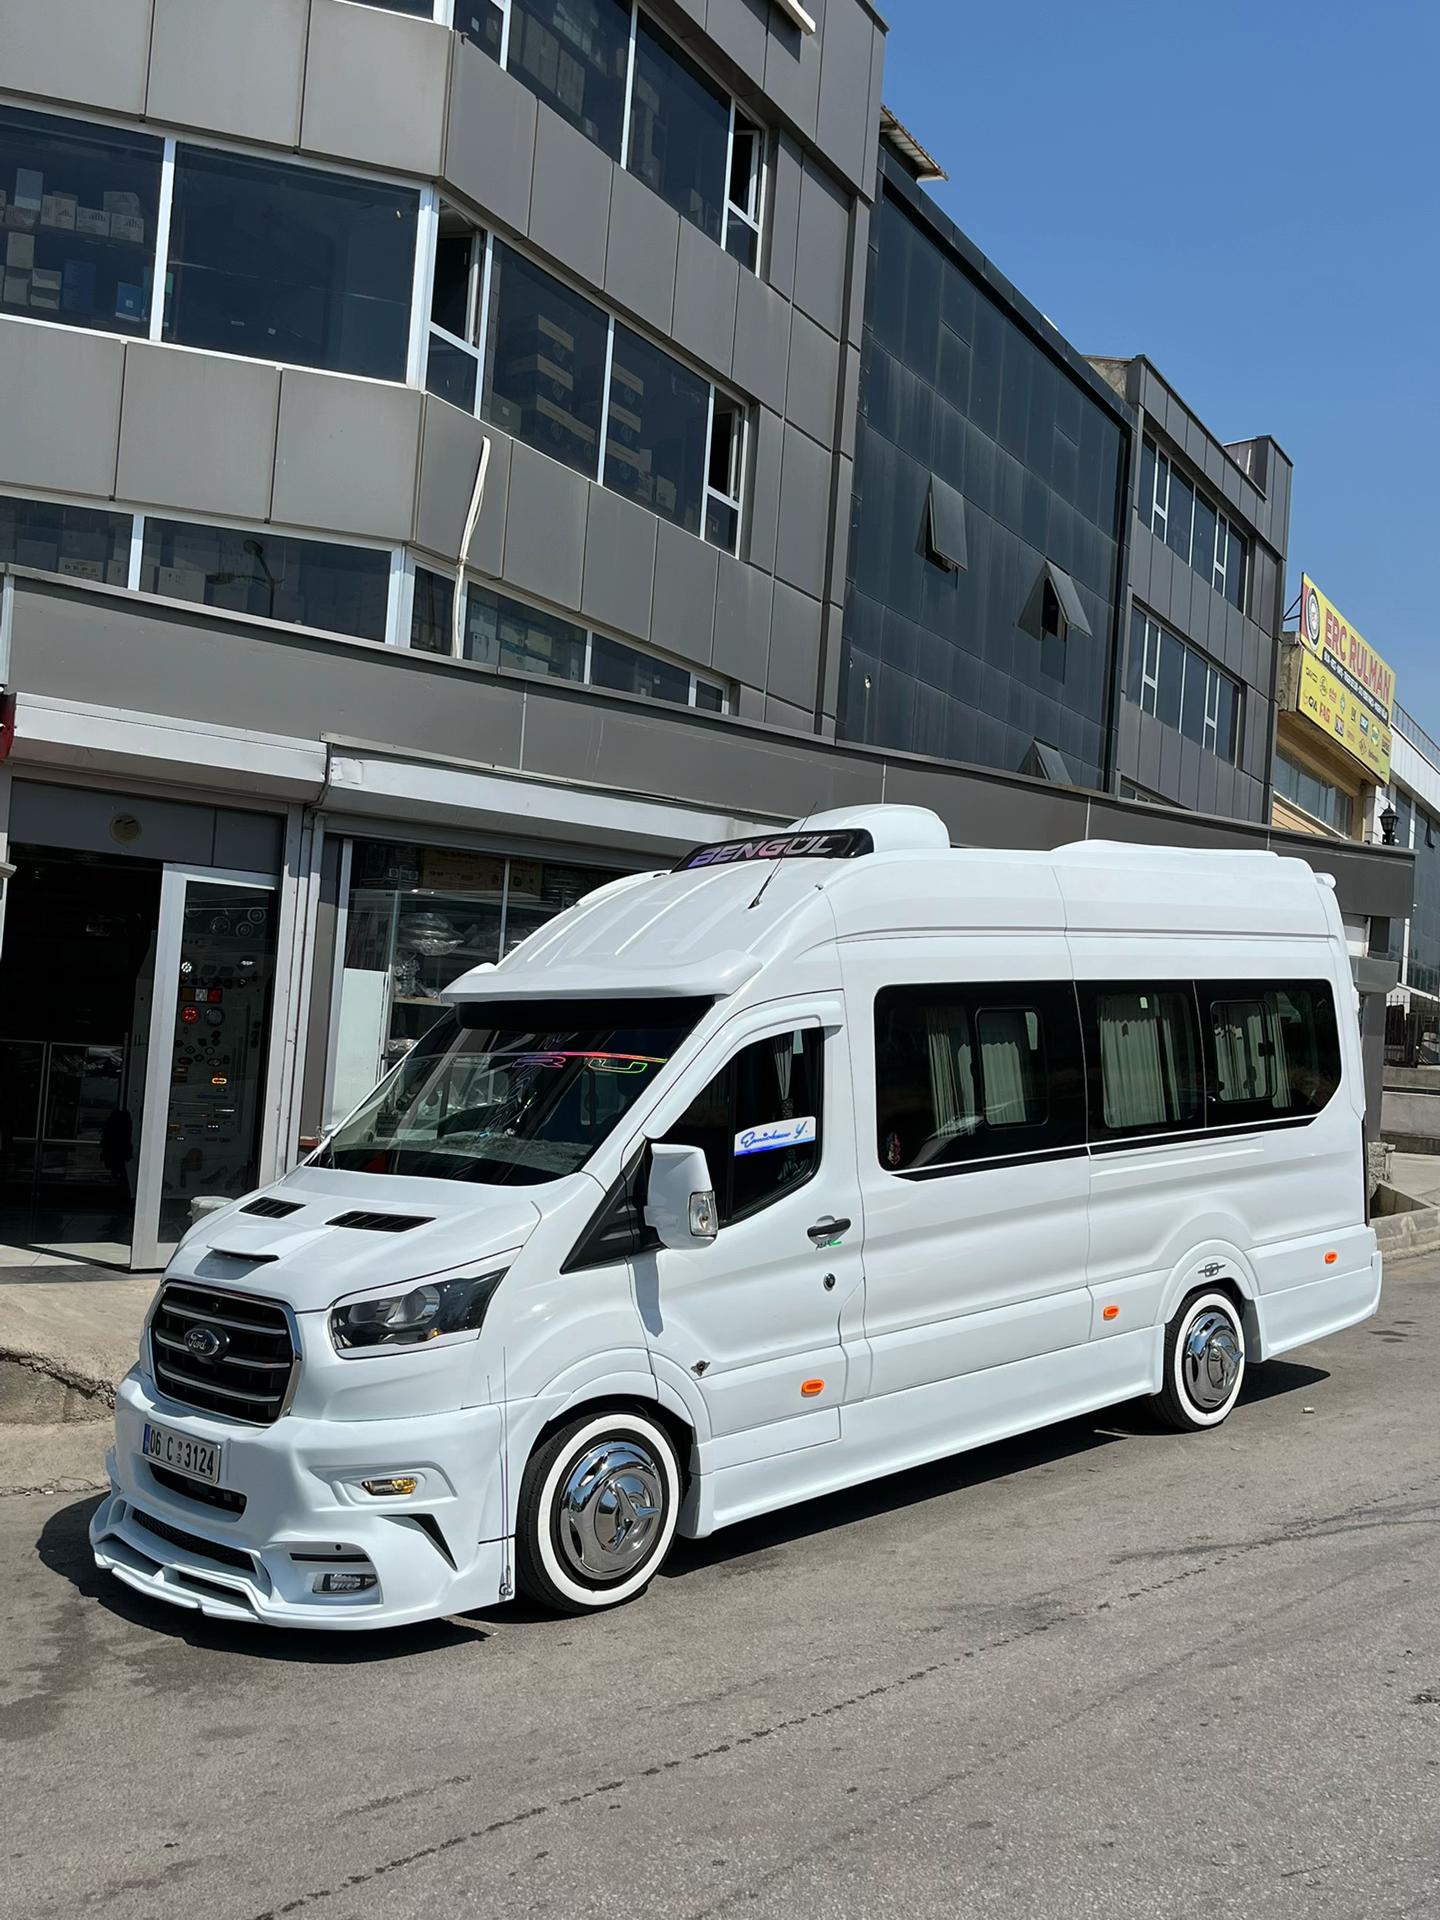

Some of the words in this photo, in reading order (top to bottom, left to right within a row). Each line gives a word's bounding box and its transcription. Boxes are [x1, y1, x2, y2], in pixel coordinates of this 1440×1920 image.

[1324, 607, 1347, 661] ERC
[1348, 634, 1391, 705] RULMAN
[188, 1332, 208, 1350] Ford
[149, 1429, 162, 1456] 06
[166, 1436, 174, 1461] C
[184, 1442, 214, 1476] 3124
